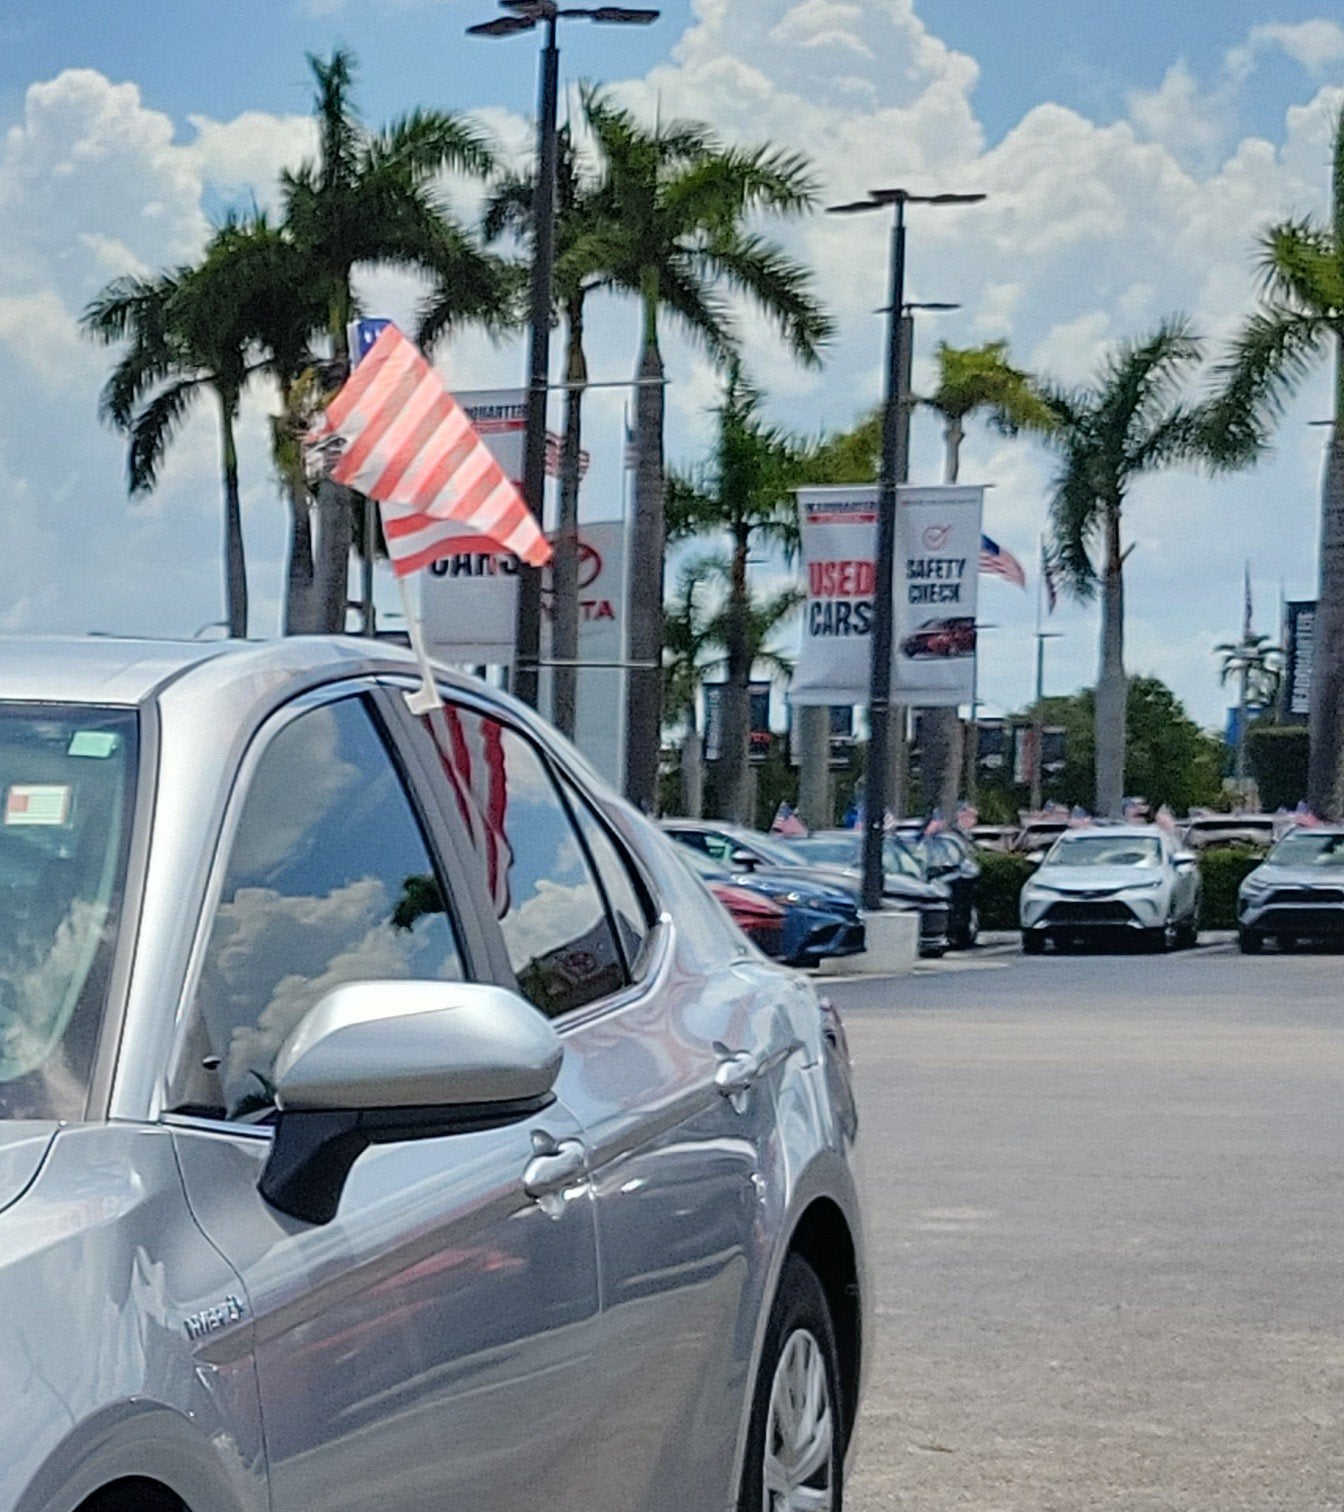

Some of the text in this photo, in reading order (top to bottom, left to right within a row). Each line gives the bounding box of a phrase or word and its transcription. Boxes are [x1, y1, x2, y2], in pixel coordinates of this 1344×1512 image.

[809, 560, 877, 596] USED
[907, 558, 966, 579] SAFETY
[908, 582, 960, 604] CHECK
[810, 601, 874, 636] CARS
